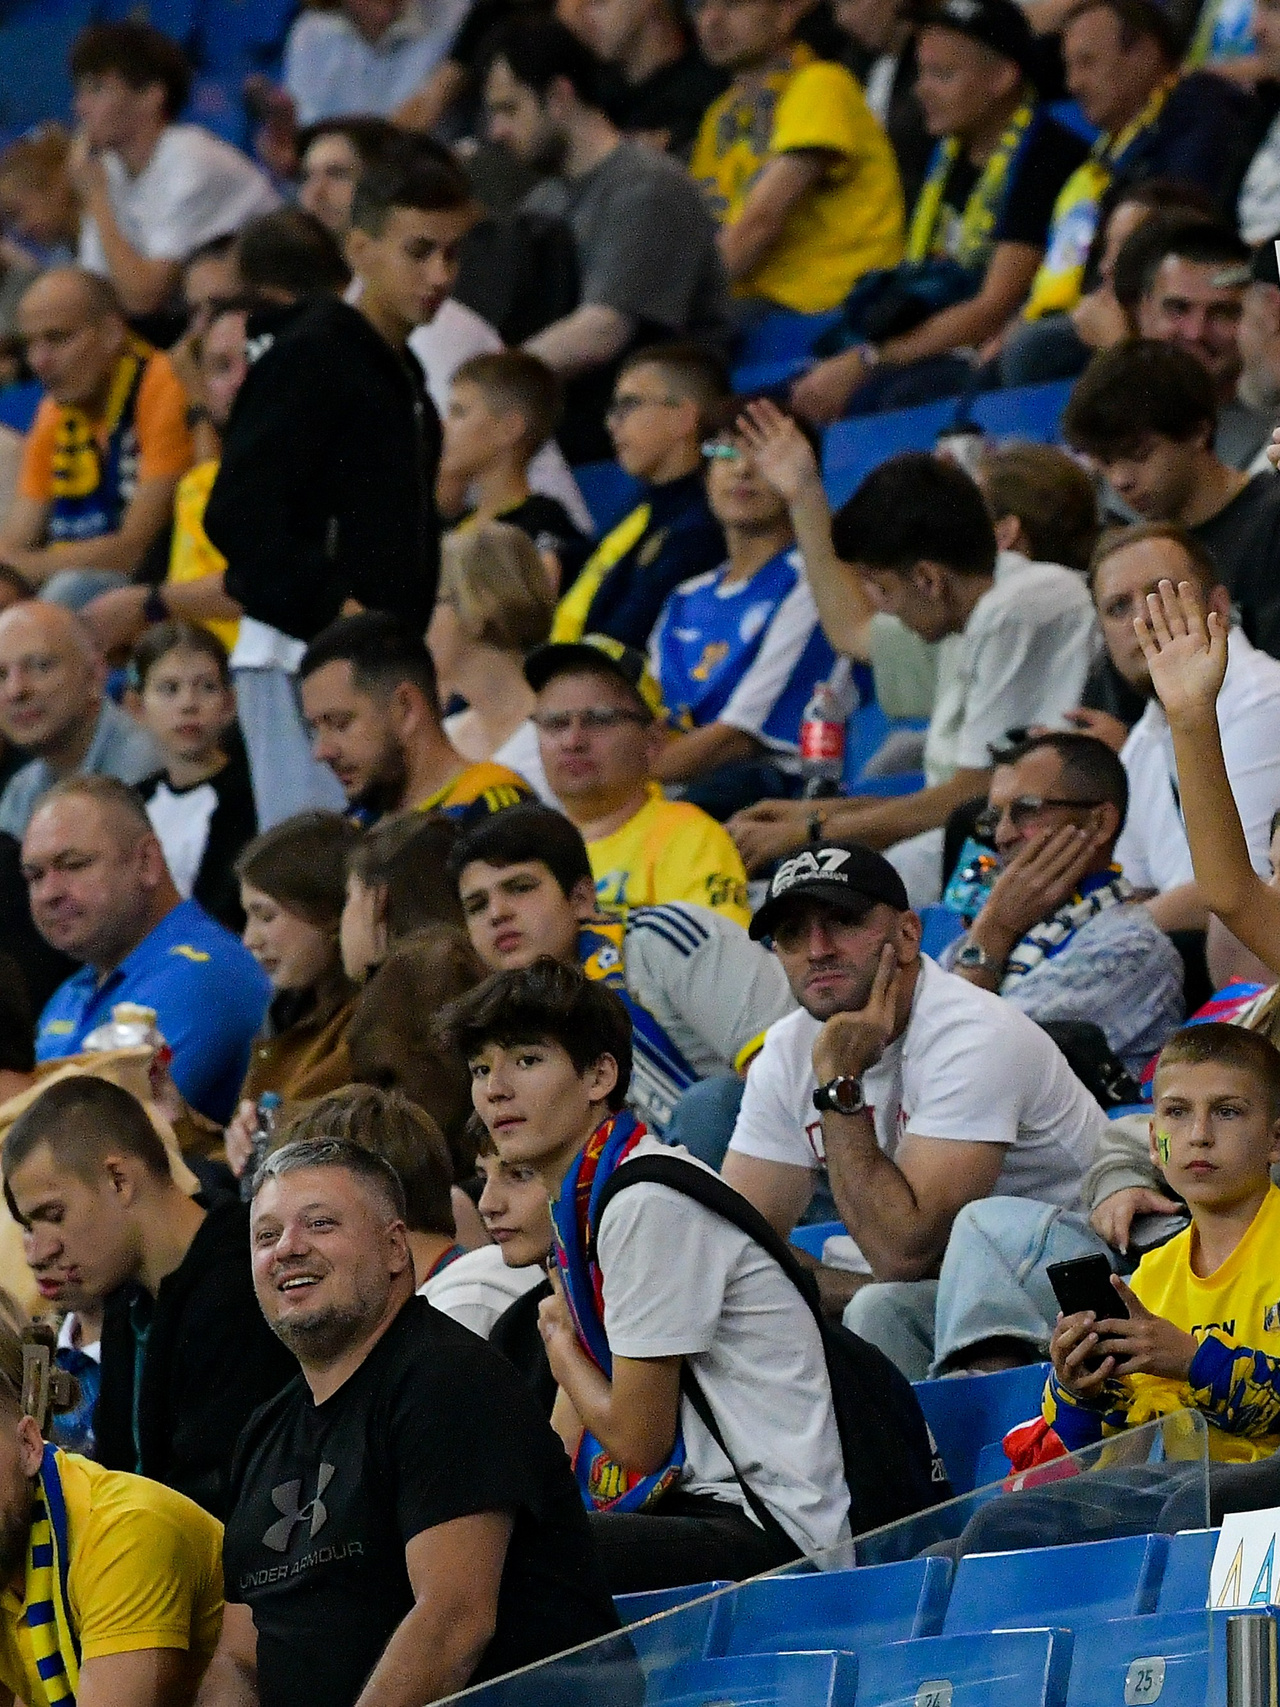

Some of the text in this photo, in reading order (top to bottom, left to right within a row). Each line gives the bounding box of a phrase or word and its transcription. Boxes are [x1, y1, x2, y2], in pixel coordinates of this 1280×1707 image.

[240, 1541, 364, 1589] UNDER ARMOUR
[1135, 1669, 1153, 1692] 25
